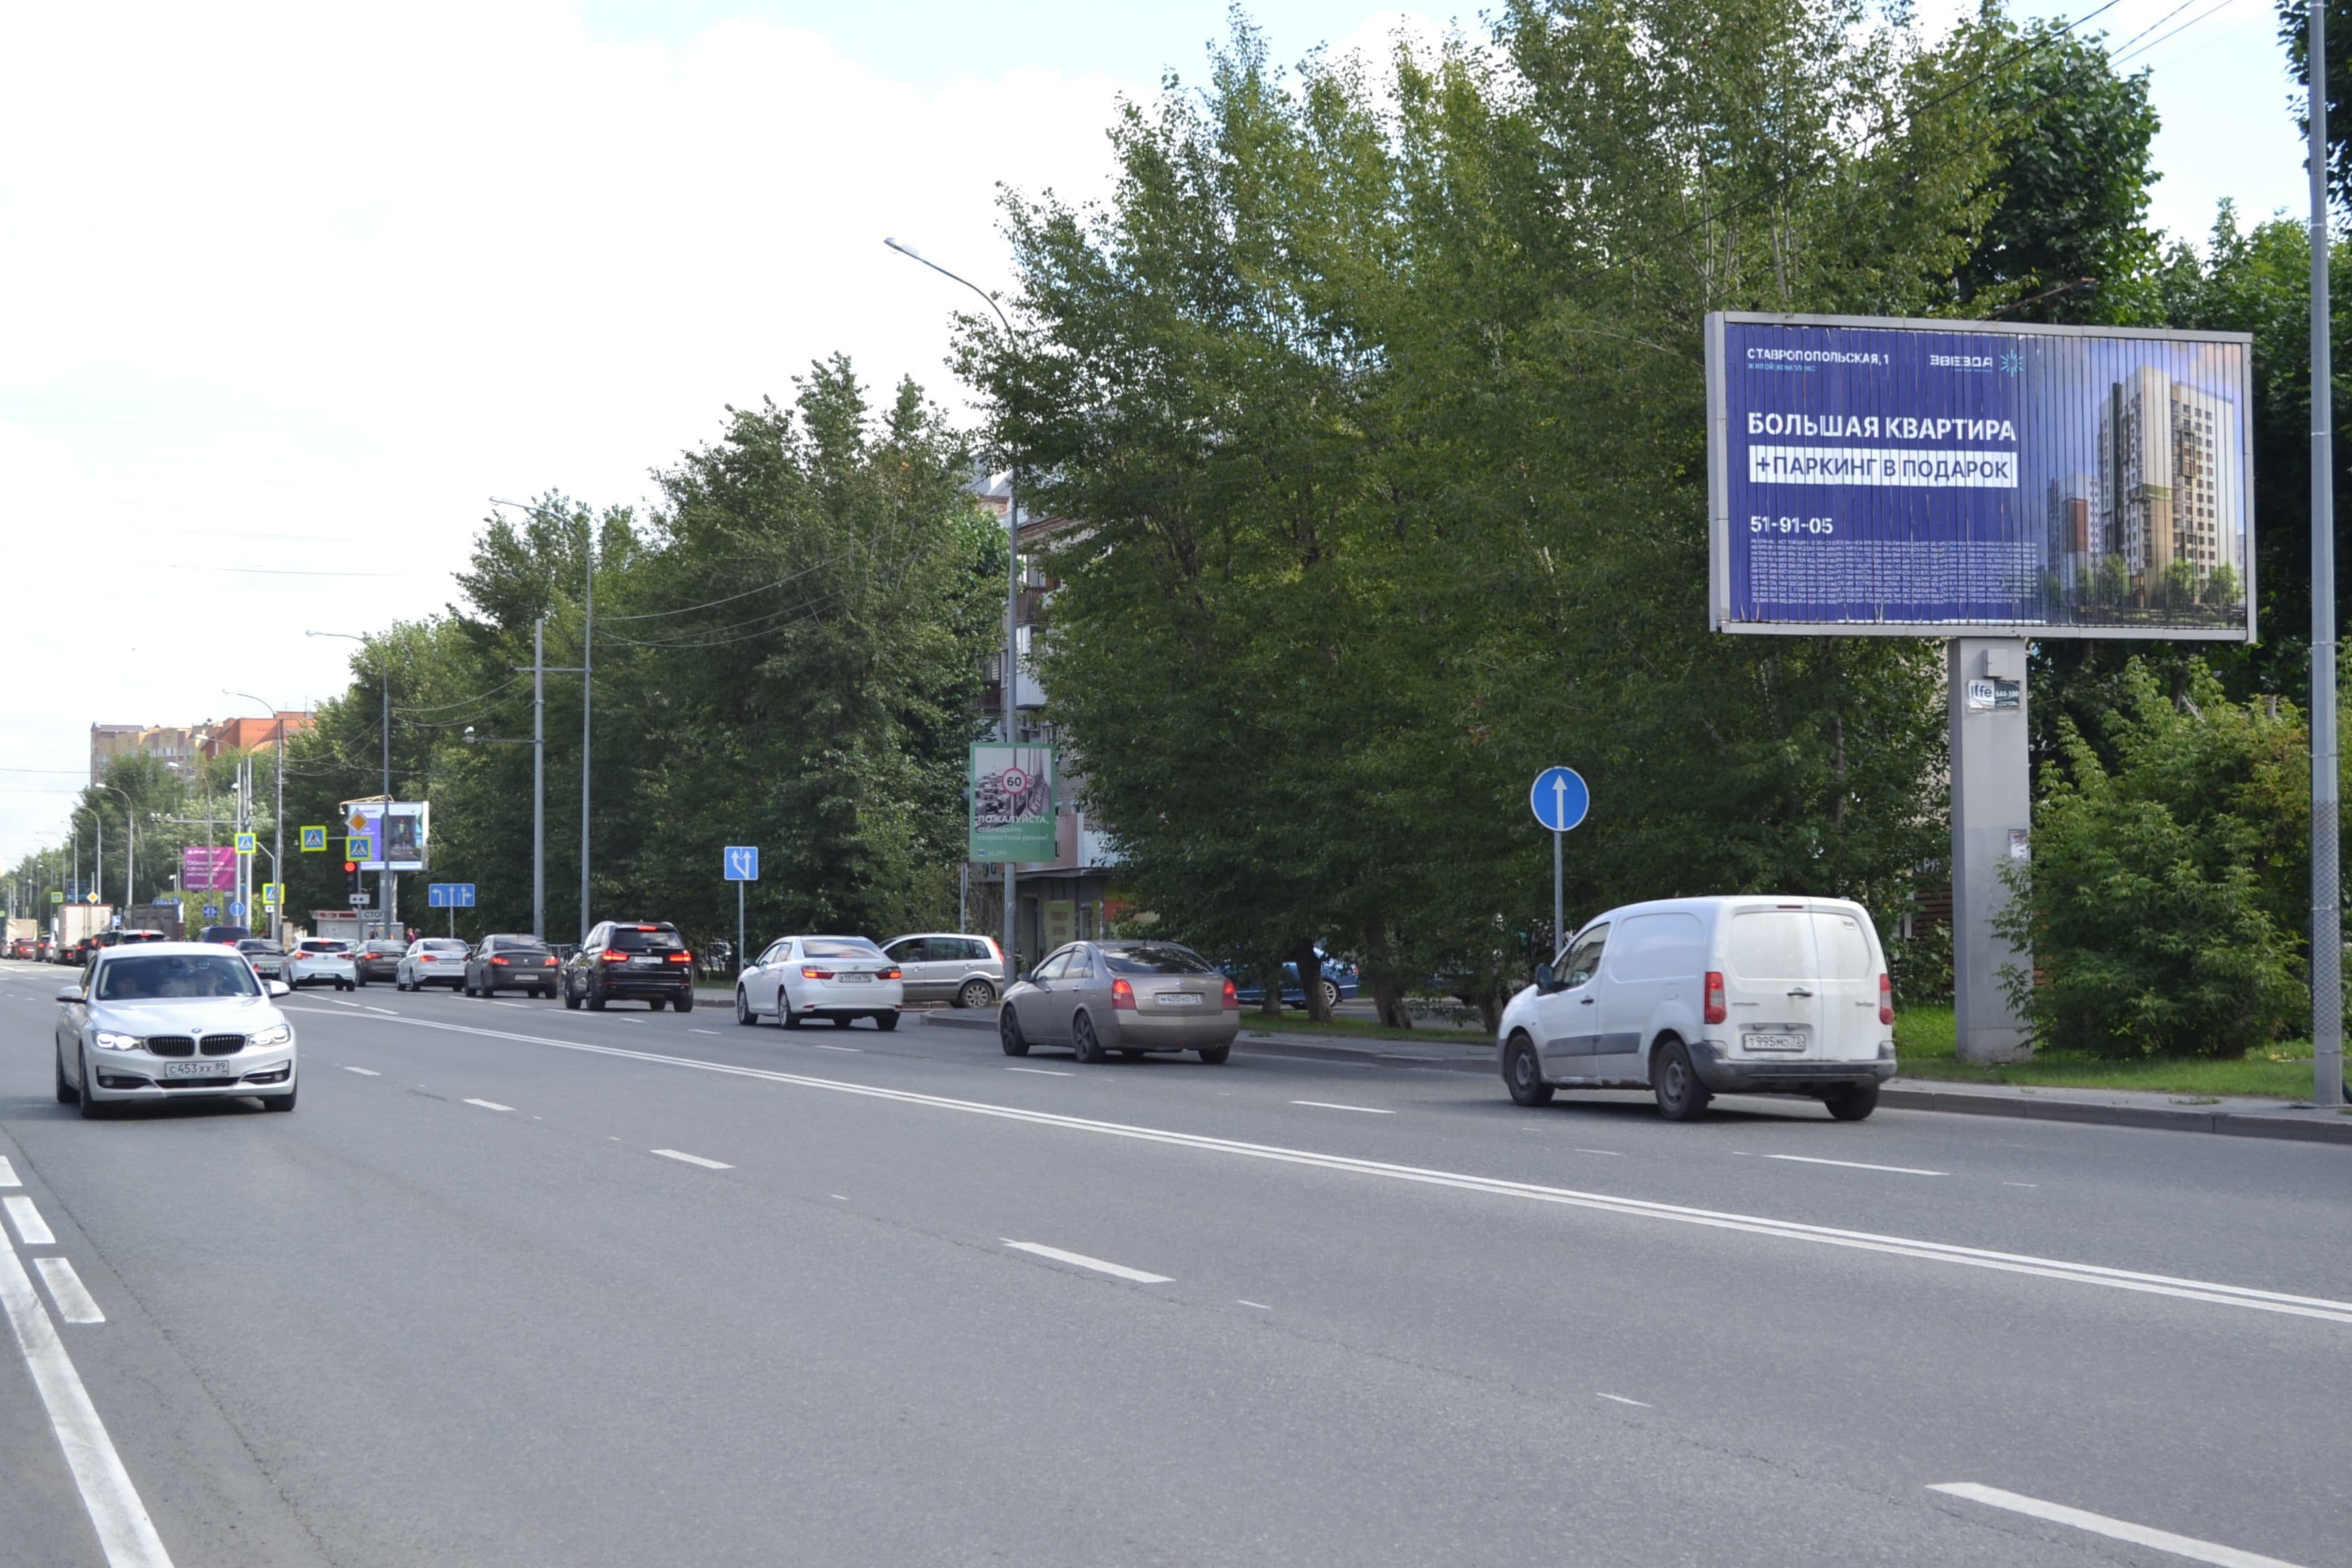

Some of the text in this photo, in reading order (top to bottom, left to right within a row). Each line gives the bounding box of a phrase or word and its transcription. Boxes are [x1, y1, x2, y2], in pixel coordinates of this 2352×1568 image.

[1883, 354, 1889, 365] 1
[1930, 355, 1993, 367] ЗВЕЗДА
[1748, 412, 2016, 441] БОЛЬШАЯ КВАРТИРА
[1884, 459, 1896, 476] В
[1903, 460, 2009, 482] ПОДАРОК
[1750, 516, 1833, 534] 51-91-05
[1007, 777, 1022, 787] 60
[978, 815, 1049, 825] ПОЖАЛУЙСТА,
